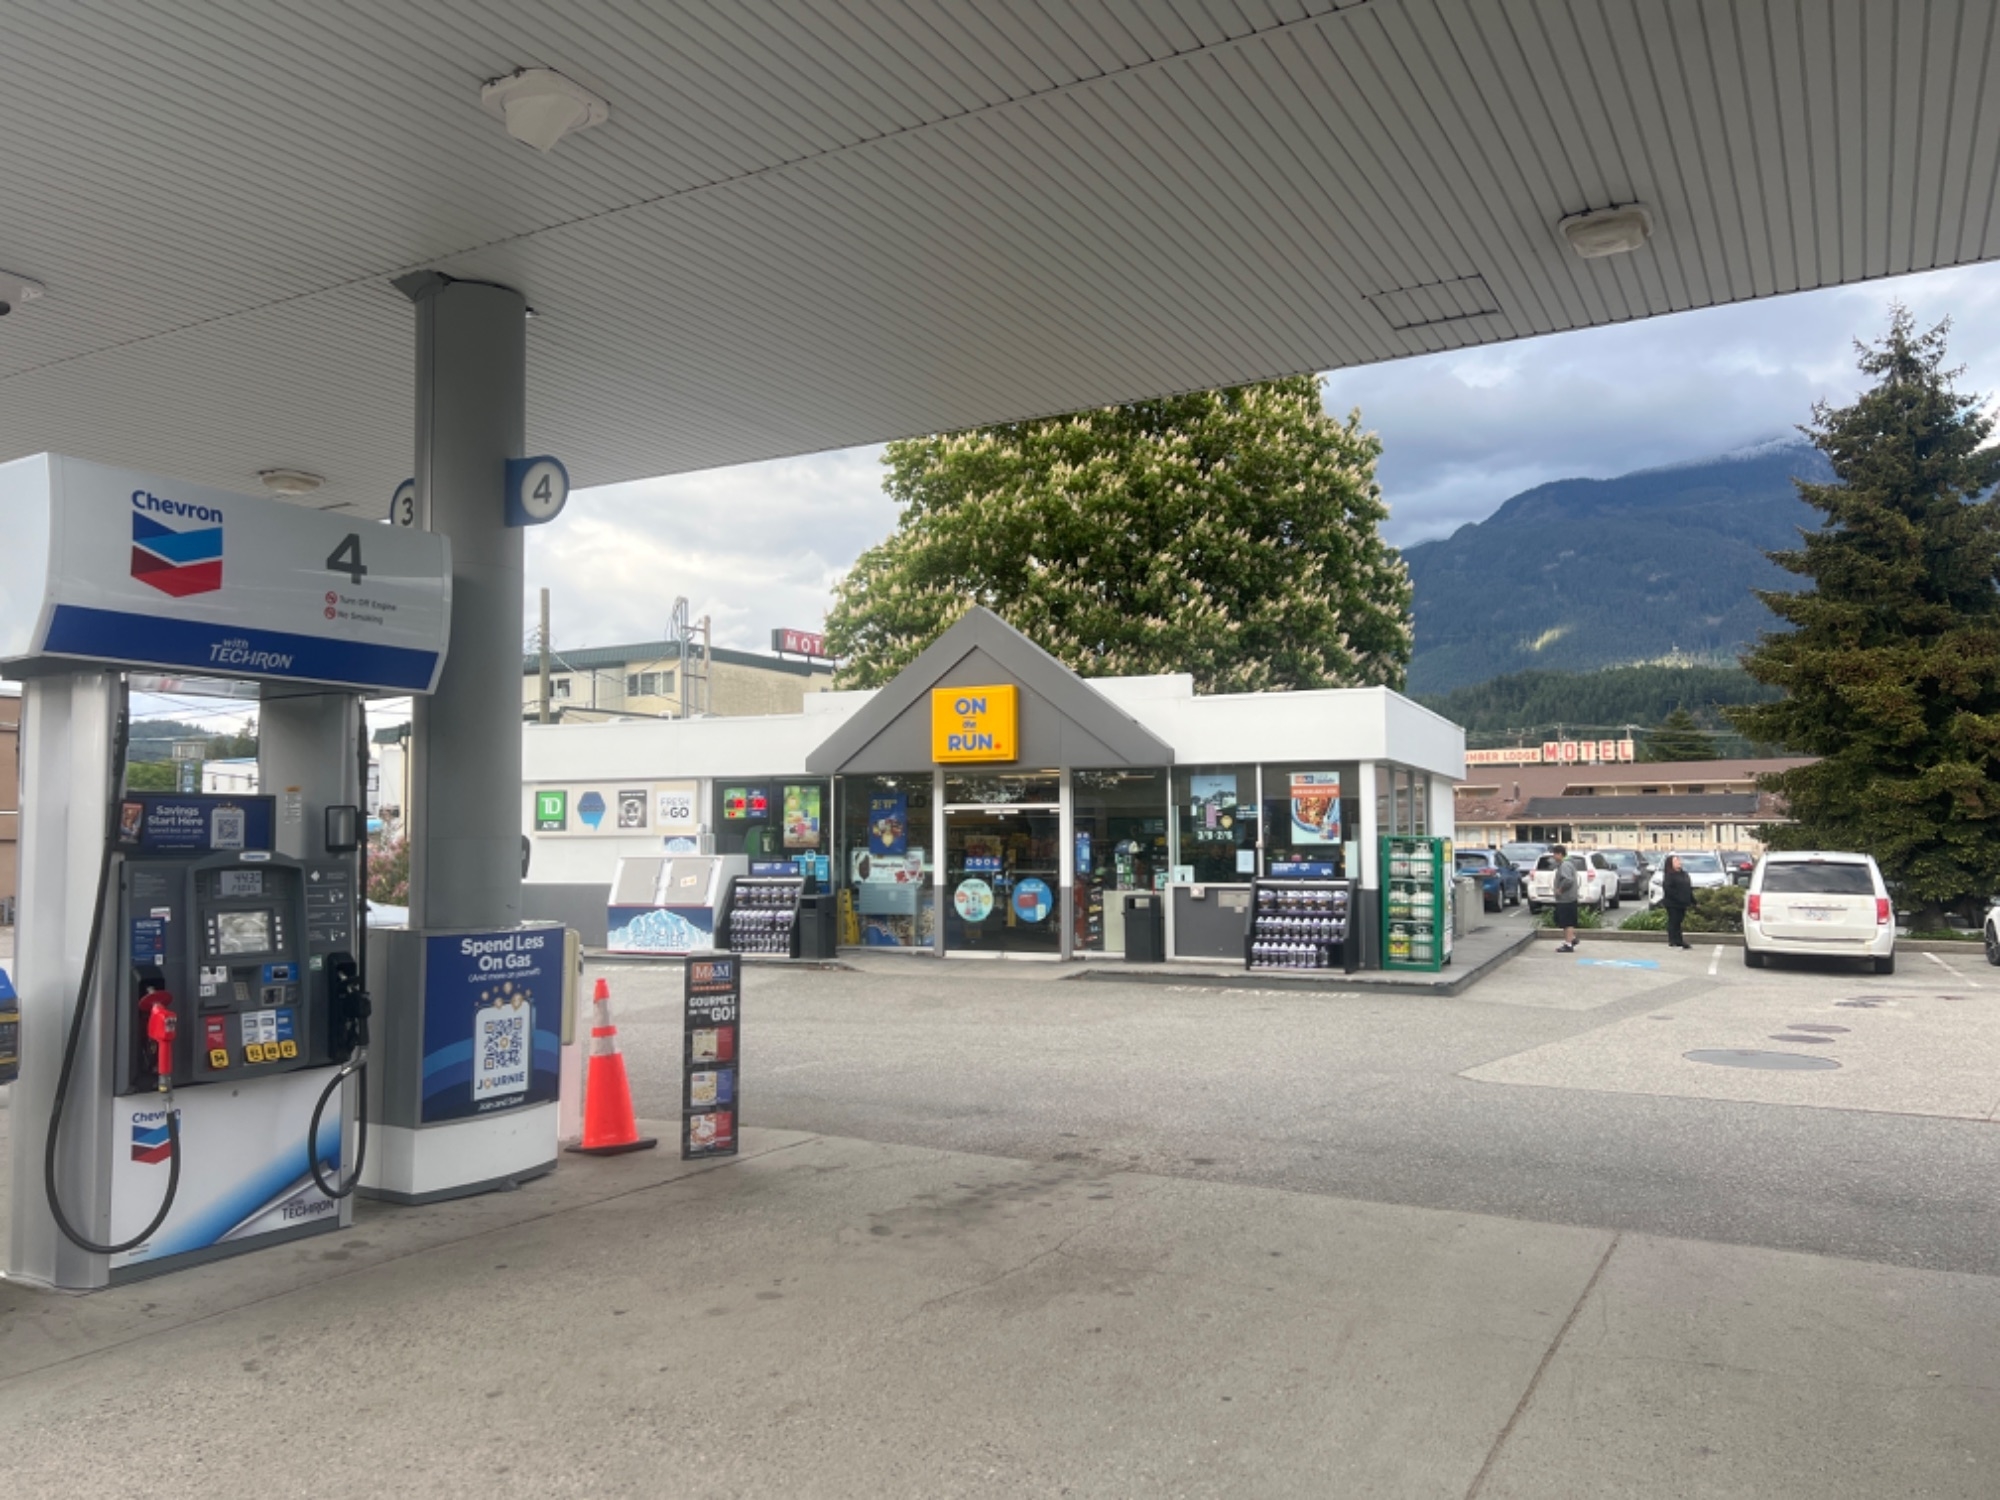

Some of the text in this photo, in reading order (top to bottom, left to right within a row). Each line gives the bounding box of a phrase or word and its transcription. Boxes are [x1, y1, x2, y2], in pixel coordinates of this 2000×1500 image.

[533, 473, 553, 505] 4
[131, 490, 223, 523] Chevron
[401, 497, 414, 526] 3
[326, 532, 367, 586] 4
[371, 600, 398, 612] Engine
[350, 611, 384, 626] Smoking
[222, 637, 249, 650] with
[785, 634, 825, 655] MOT
[209, 644, 293, 671] TECHRON
[954, 696, 986, 715] ON
[962, 719, 977, 731] the
[947, 734, 993, 752] RUN
[1503, 749, 1538, 761] LODGE
[1545, 741, 1632, 761] MOTEL
[541, 797, 561, 815] TD
[660, 797, 689, 807] FRESH
[155, 805, 200, 818] Savings
[669, 806, 690, 819] GO
[148, 815, 204, 827] Start Here
[542, 821, 560, 829] ATM
[460, 934, 545, 957] Spend Less
[478, 953, 532, 971] On Gas
[695, 964, 730, 980] M&M
[690, 994, 737, 1008] GOURMET
[711, 1005, 736, 1022] GO!
[476, 1071, 526, 1090] JOURNIE
[131, 1107, 182, 1125] Chevrn
[281, 1199, 335, 1222] TECHRON
